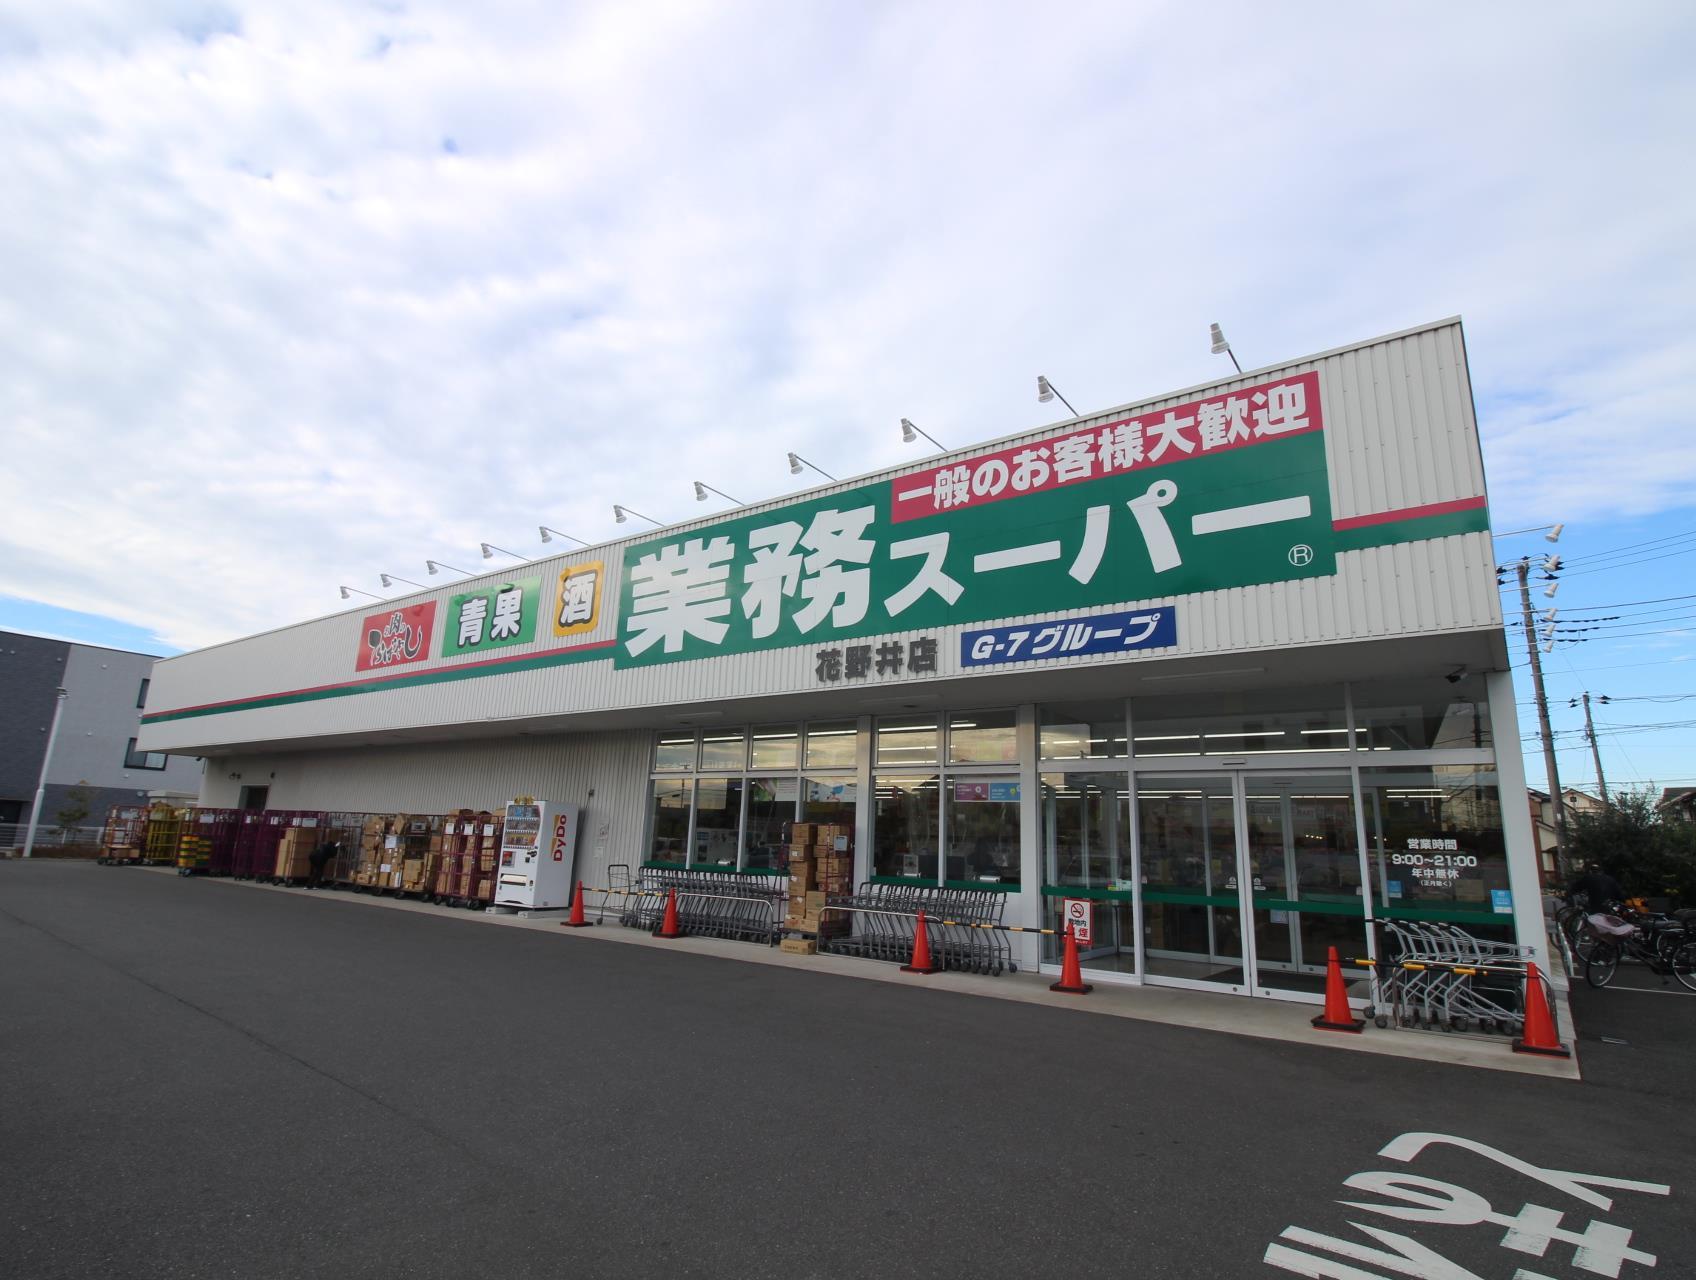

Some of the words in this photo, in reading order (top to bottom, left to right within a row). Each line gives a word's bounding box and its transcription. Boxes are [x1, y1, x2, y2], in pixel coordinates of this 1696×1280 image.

[898, 382, 1311, 510] 一般のお客様大歓迎
[624, 479, 1312, 657] 業務スーパー
[458, 588, 522, 648] 青果
[559, 572, 597, 625] 酒
[815, 636, 938, 683] 花野井店
[971, 612, 1162, 661] G-7グループ
[552, 814, 567, 862] DyDo
[1406, 838, 1458, 851] 営業時間
[1411, 868, 1460, 880] 年中無休
